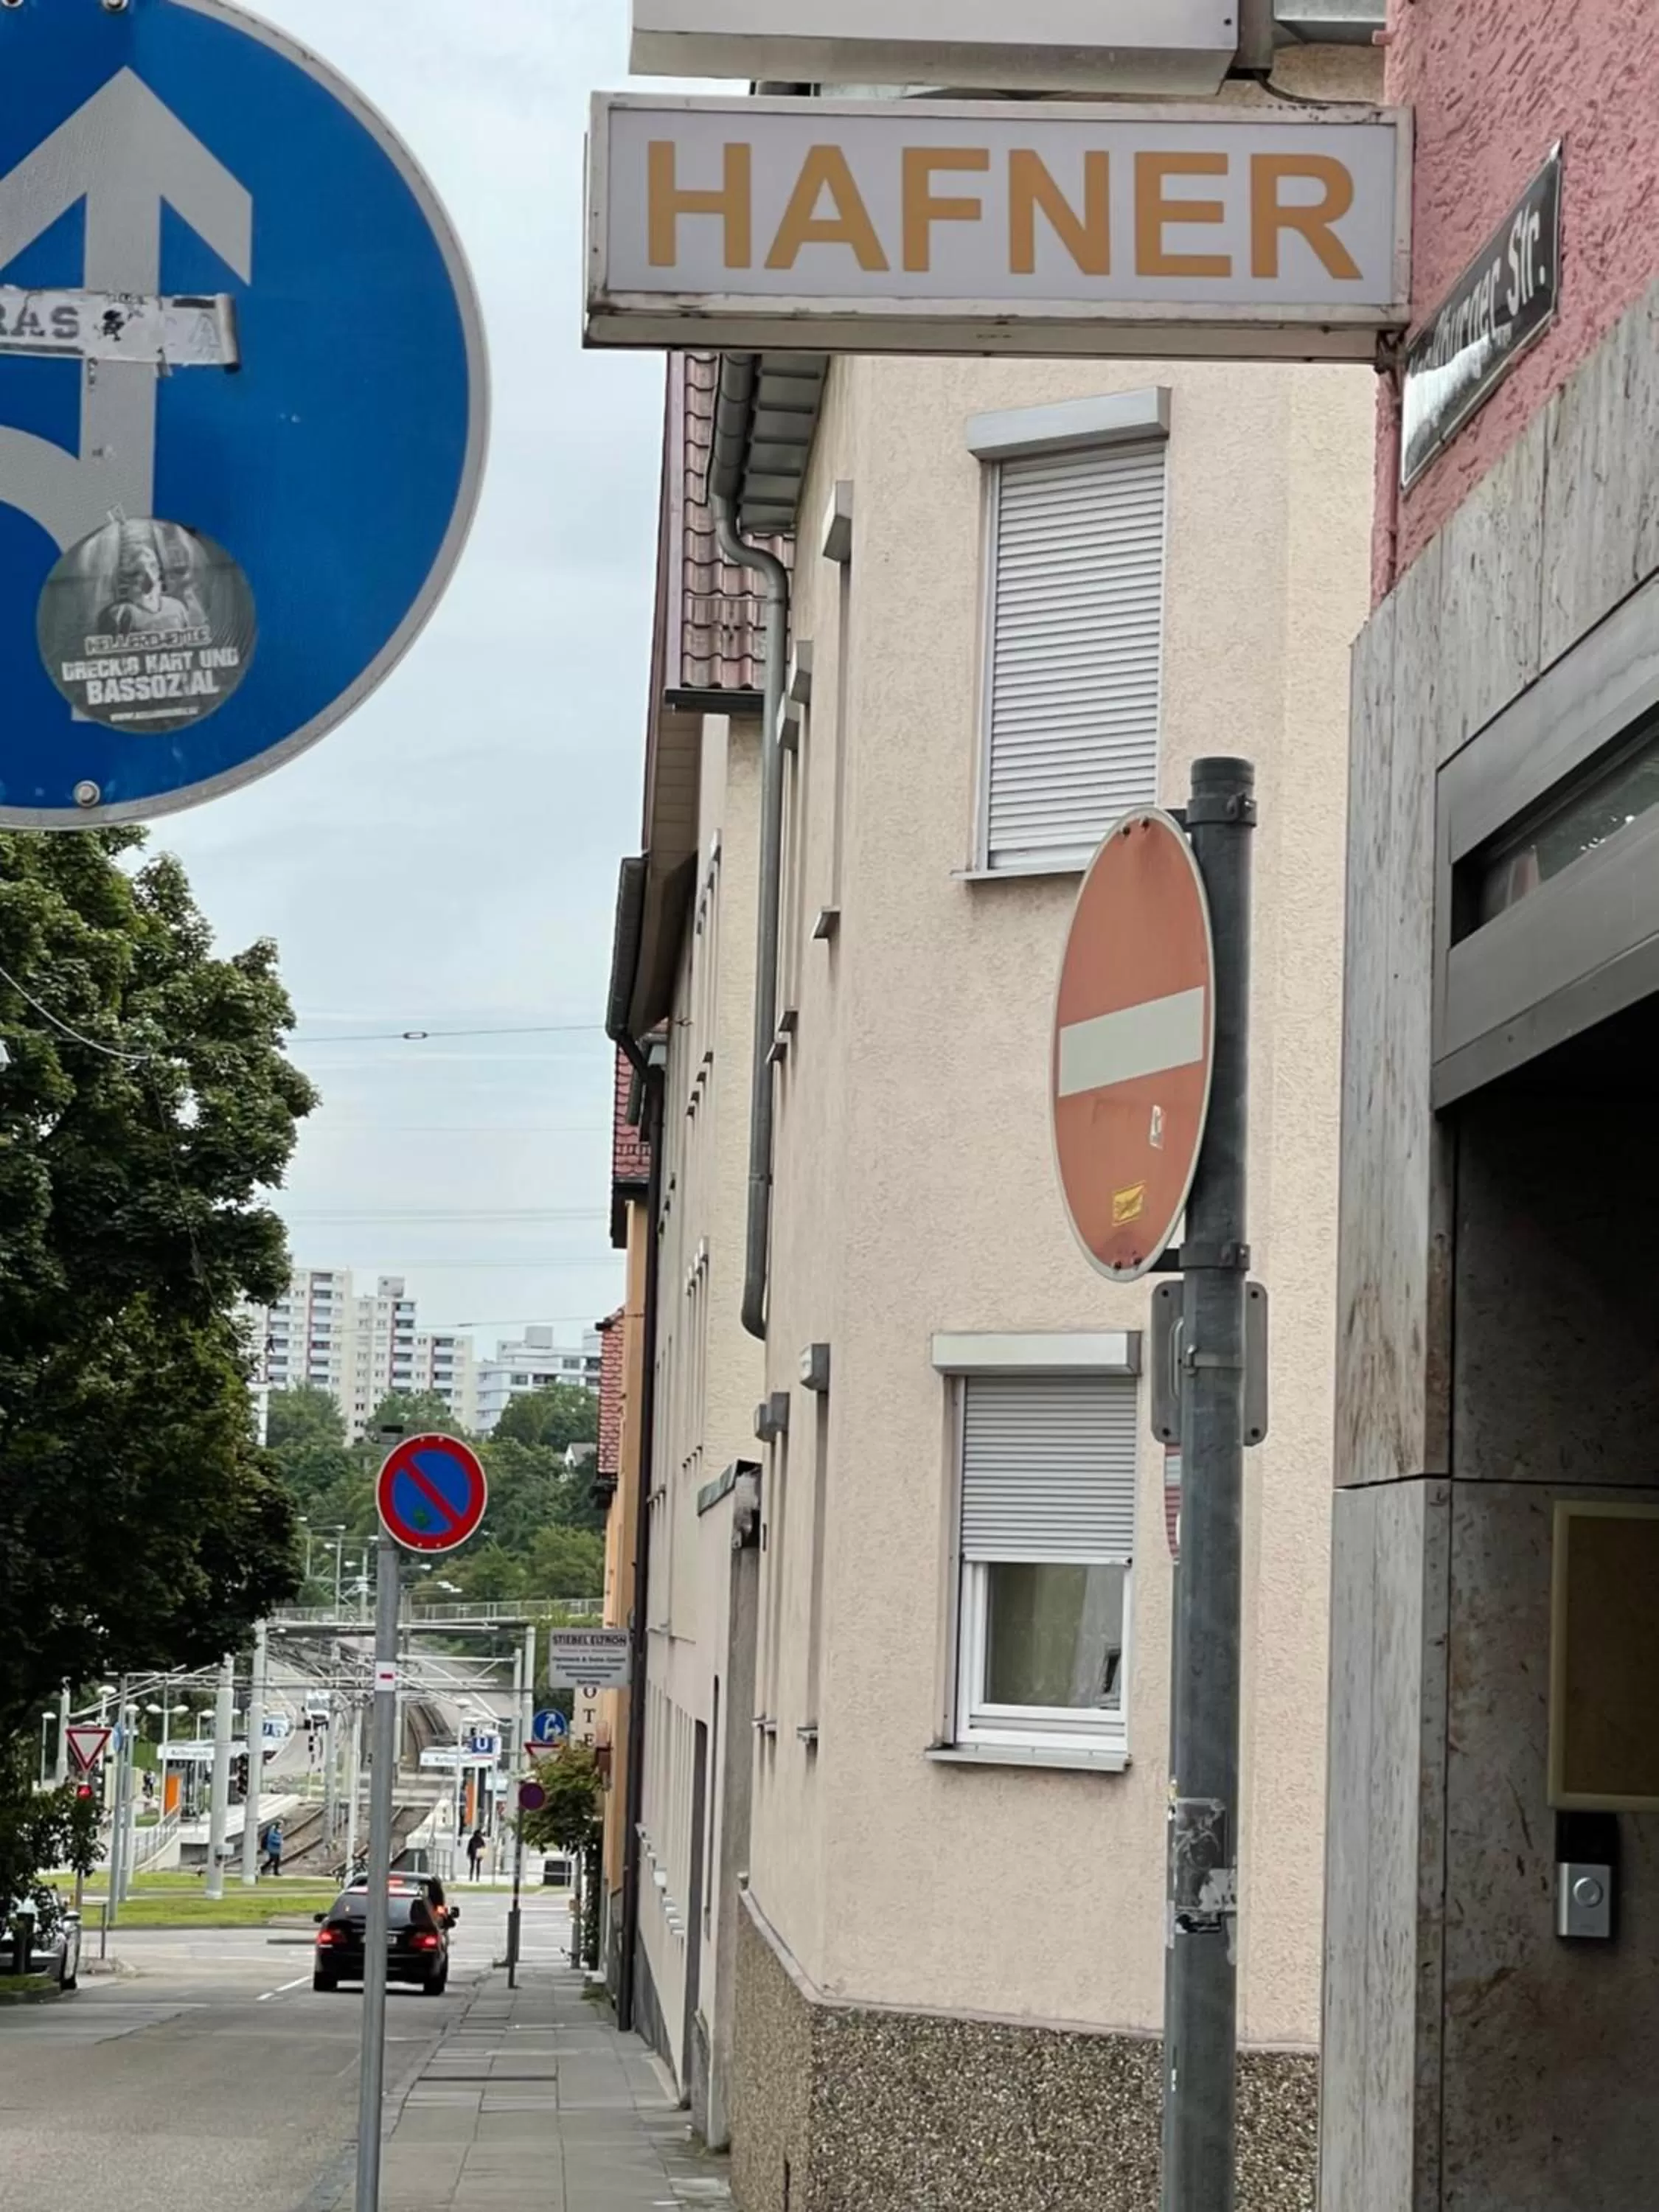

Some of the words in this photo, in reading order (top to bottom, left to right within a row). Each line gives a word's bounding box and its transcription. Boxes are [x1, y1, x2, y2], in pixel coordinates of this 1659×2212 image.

[647, 139, 1364, 280] HAFNER
[1506, 201, 1546, 316] Str.
[0, 302, 80, 340] AS
[145, 650, 194, 674] HART
[199, 646, 240, 668] UND
